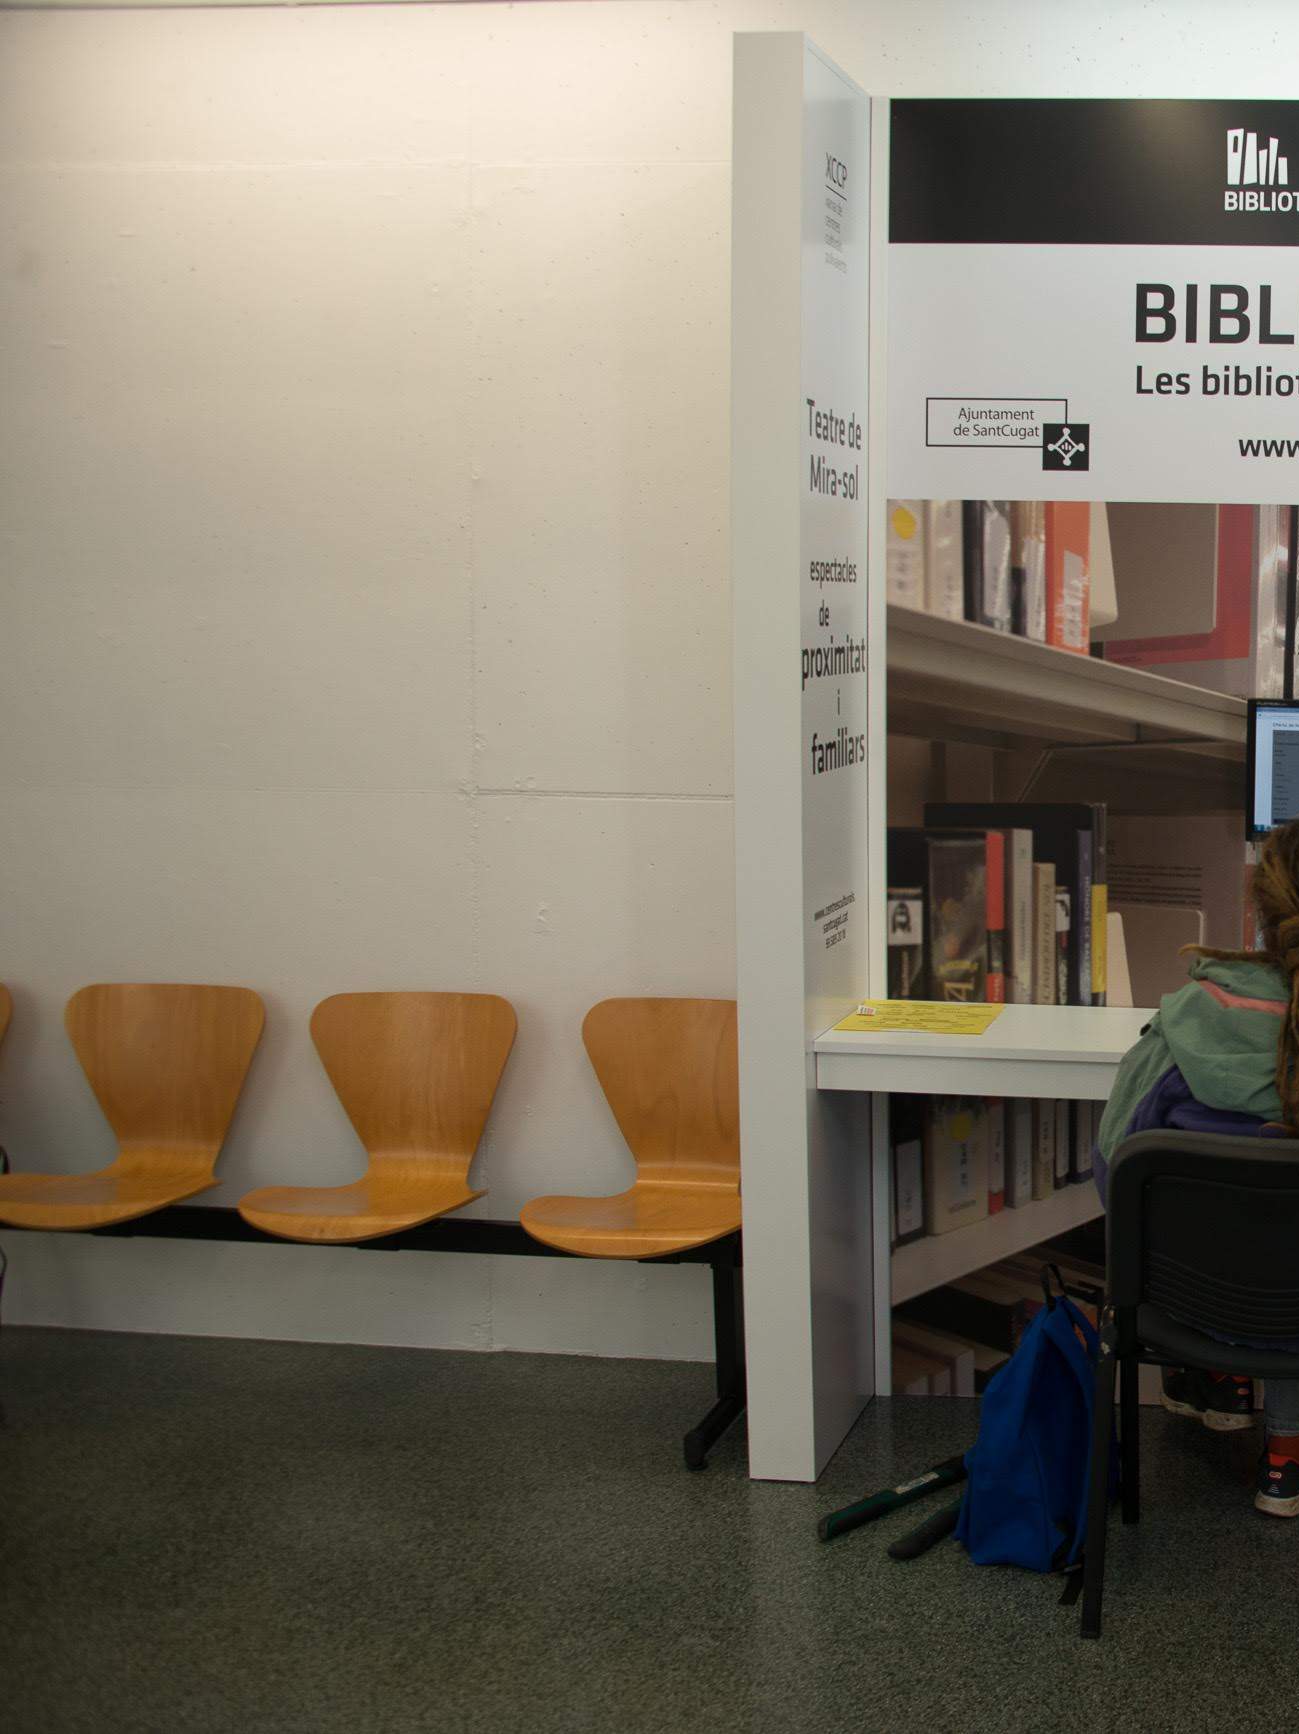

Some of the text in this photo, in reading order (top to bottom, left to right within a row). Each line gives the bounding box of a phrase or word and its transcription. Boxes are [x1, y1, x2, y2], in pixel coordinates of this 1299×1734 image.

[825, 152, 848, 189] XCCP
[1135, 365, 1191, 395] Les
[807, 398, 862, 450] Teatre de
[957, 408, 1035, 423] Ajuntament
[953, 425, 1040, 440] de SantCugat
[810, 454, 859, 501] Mira-sol
[809, 557, 857, 589] espectacles
[819, 600, 830, 626] de
[801, 634, 866, 691] proximitat
[837, 689, 841, 715] i
[811, 727, 865, 775] familiars
